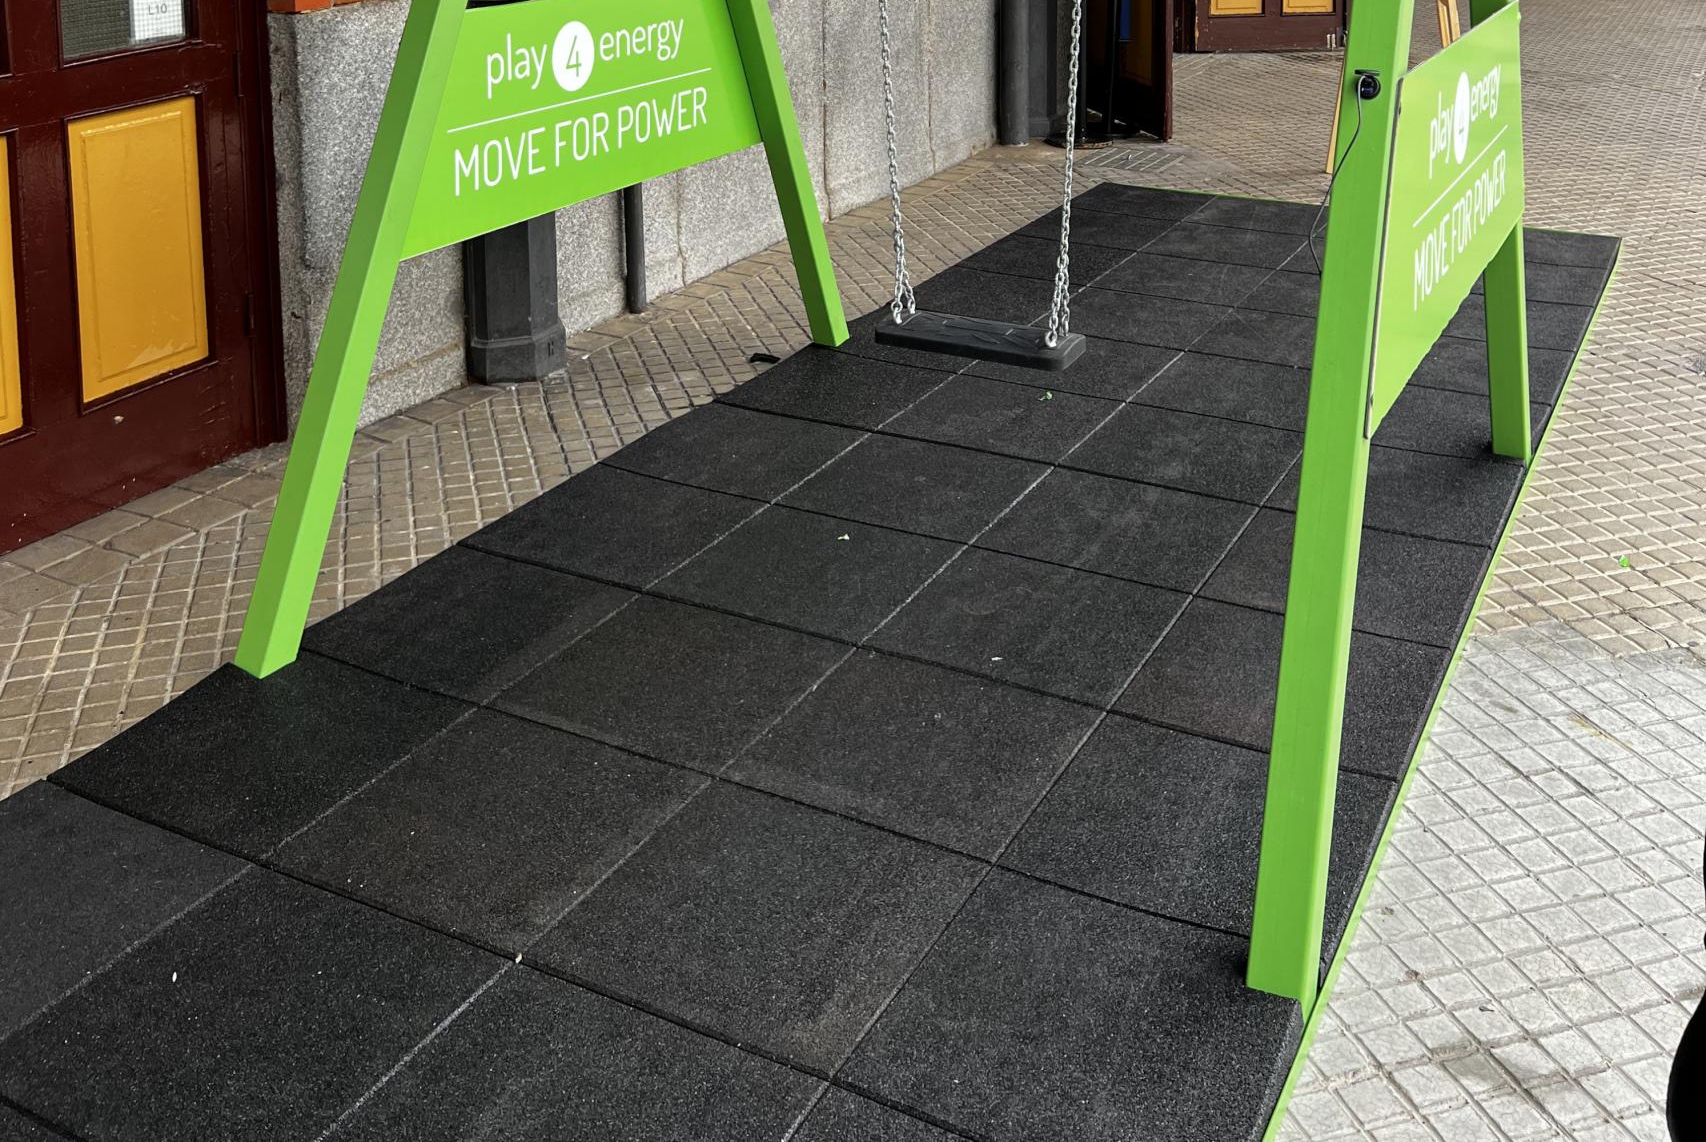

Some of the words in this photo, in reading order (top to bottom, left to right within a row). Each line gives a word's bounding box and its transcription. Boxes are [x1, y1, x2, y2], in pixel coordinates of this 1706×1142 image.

[486, 33, 548, 99] play
[565, 35, 582, 78] 4
[600, 18, 684, 62] energy
[453, 127, 546, 197] MOVE
[555, 112, 609, 167] FOR
[617, 86, 708, 149] POWER
[1429, 90, 1454, 180] play
[1470, 63, 1502, 120] energy
[1414, 212, 1450, 311] MOVE
[1451, 188, 1473, 264] FOR
[1473, 149, 1506, 235] POWER
